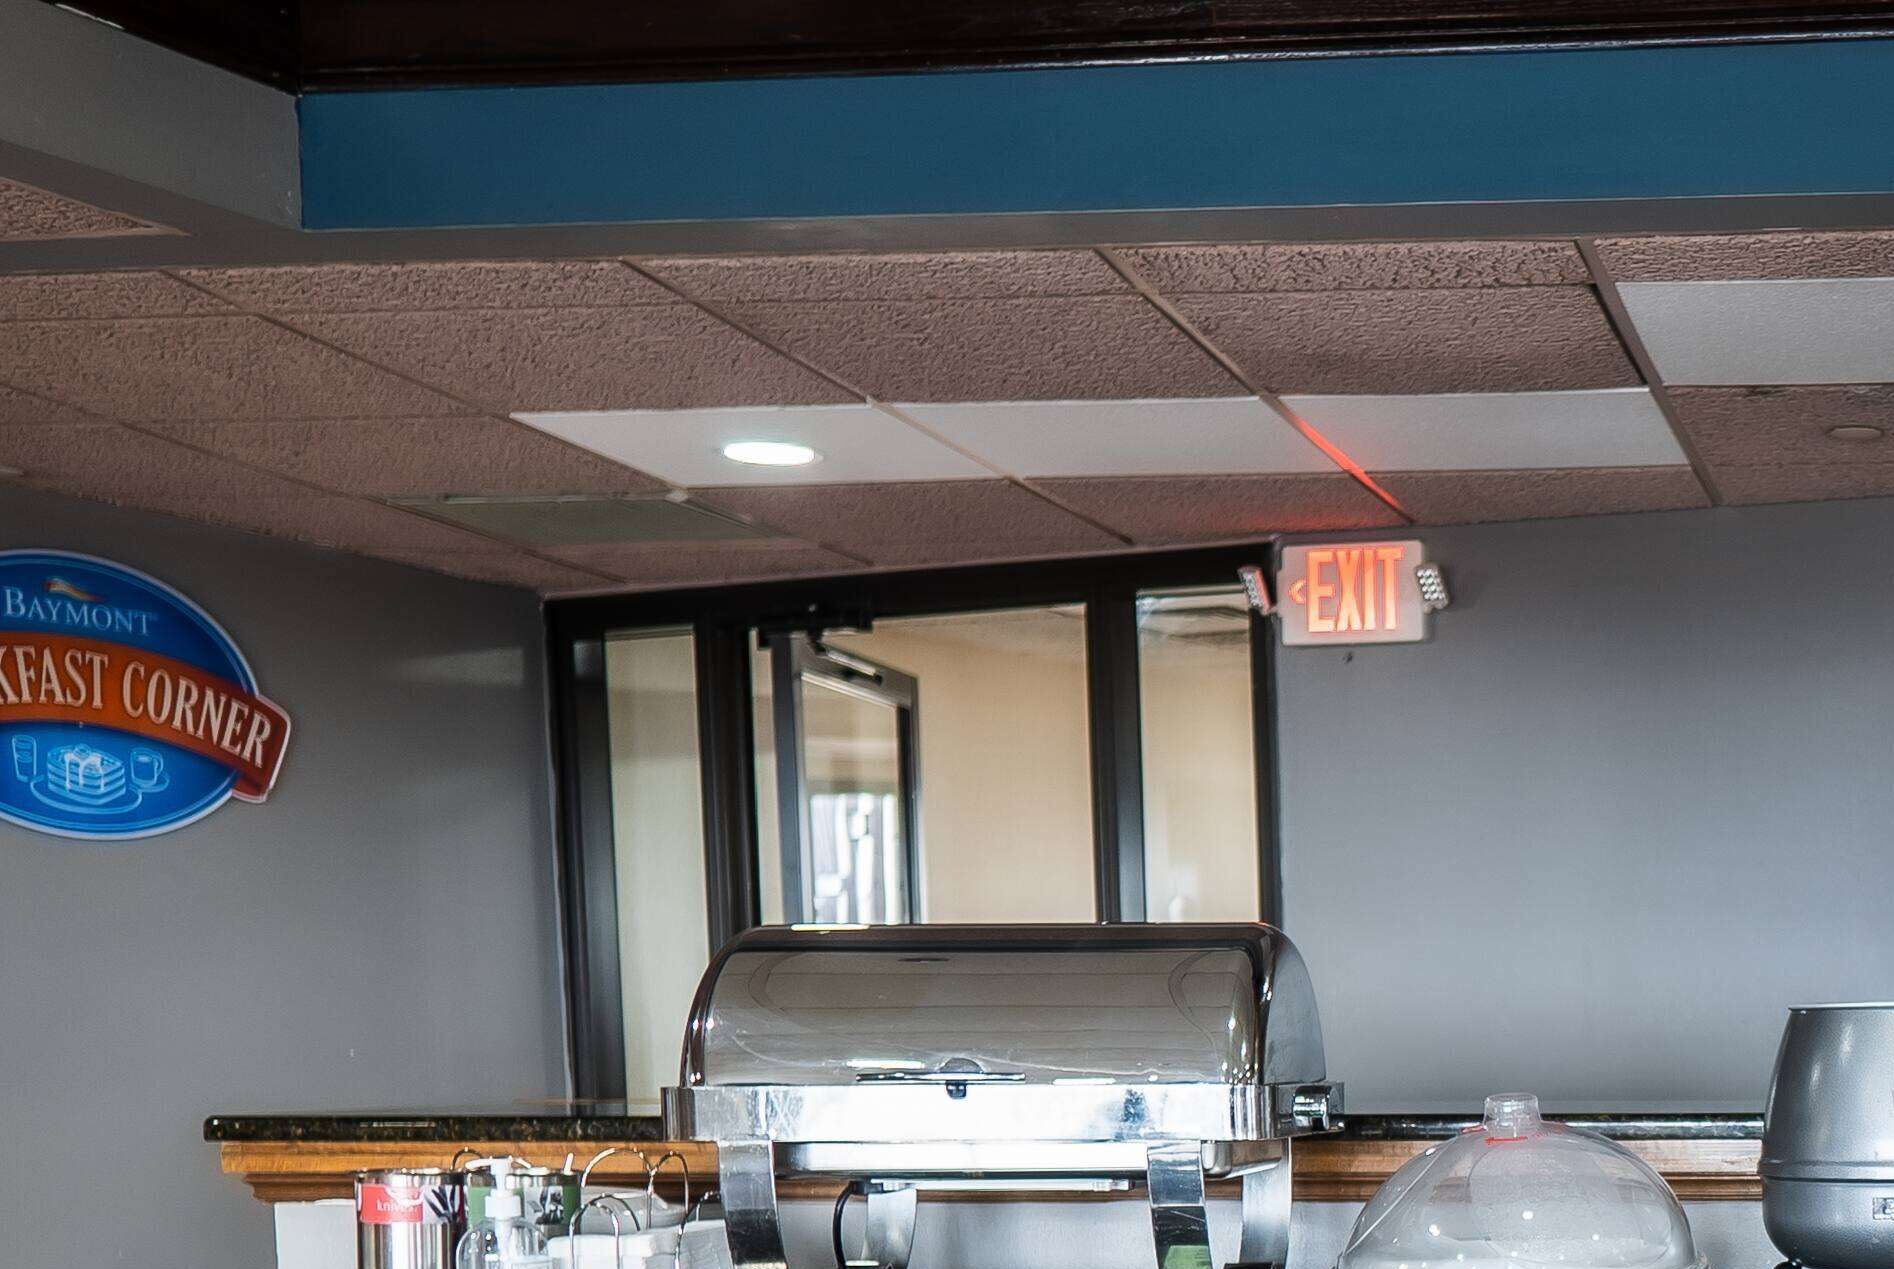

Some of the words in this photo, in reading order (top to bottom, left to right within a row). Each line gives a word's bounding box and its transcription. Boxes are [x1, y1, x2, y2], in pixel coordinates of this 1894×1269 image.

[4, 585, 150, 636] BAYMONT
[1307, 547, 1405, 633] EXIT
[122, 660, 271, 769] CORNER
